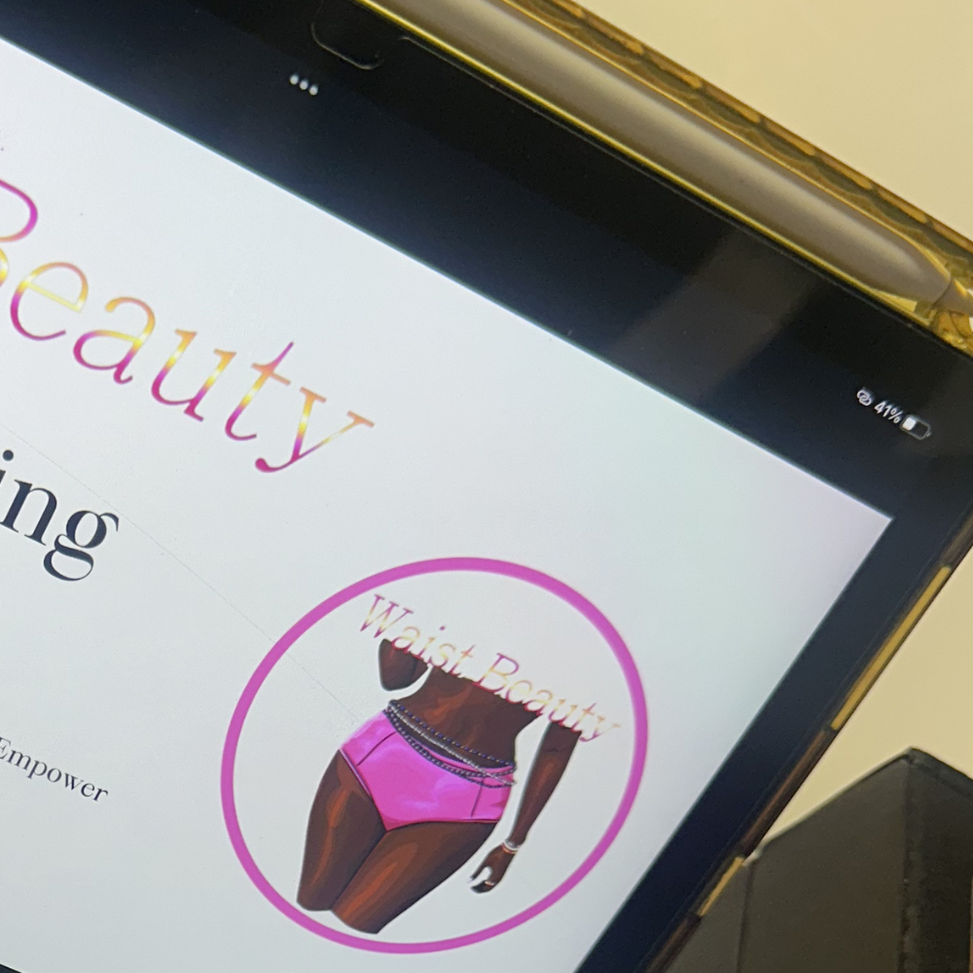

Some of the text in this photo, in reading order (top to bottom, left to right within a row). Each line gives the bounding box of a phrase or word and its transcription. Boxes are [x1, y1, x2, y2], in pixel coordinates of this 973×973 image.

[874, 401, 903, 424] 41%
[359, 595, 619, 742] Waist Beauty
